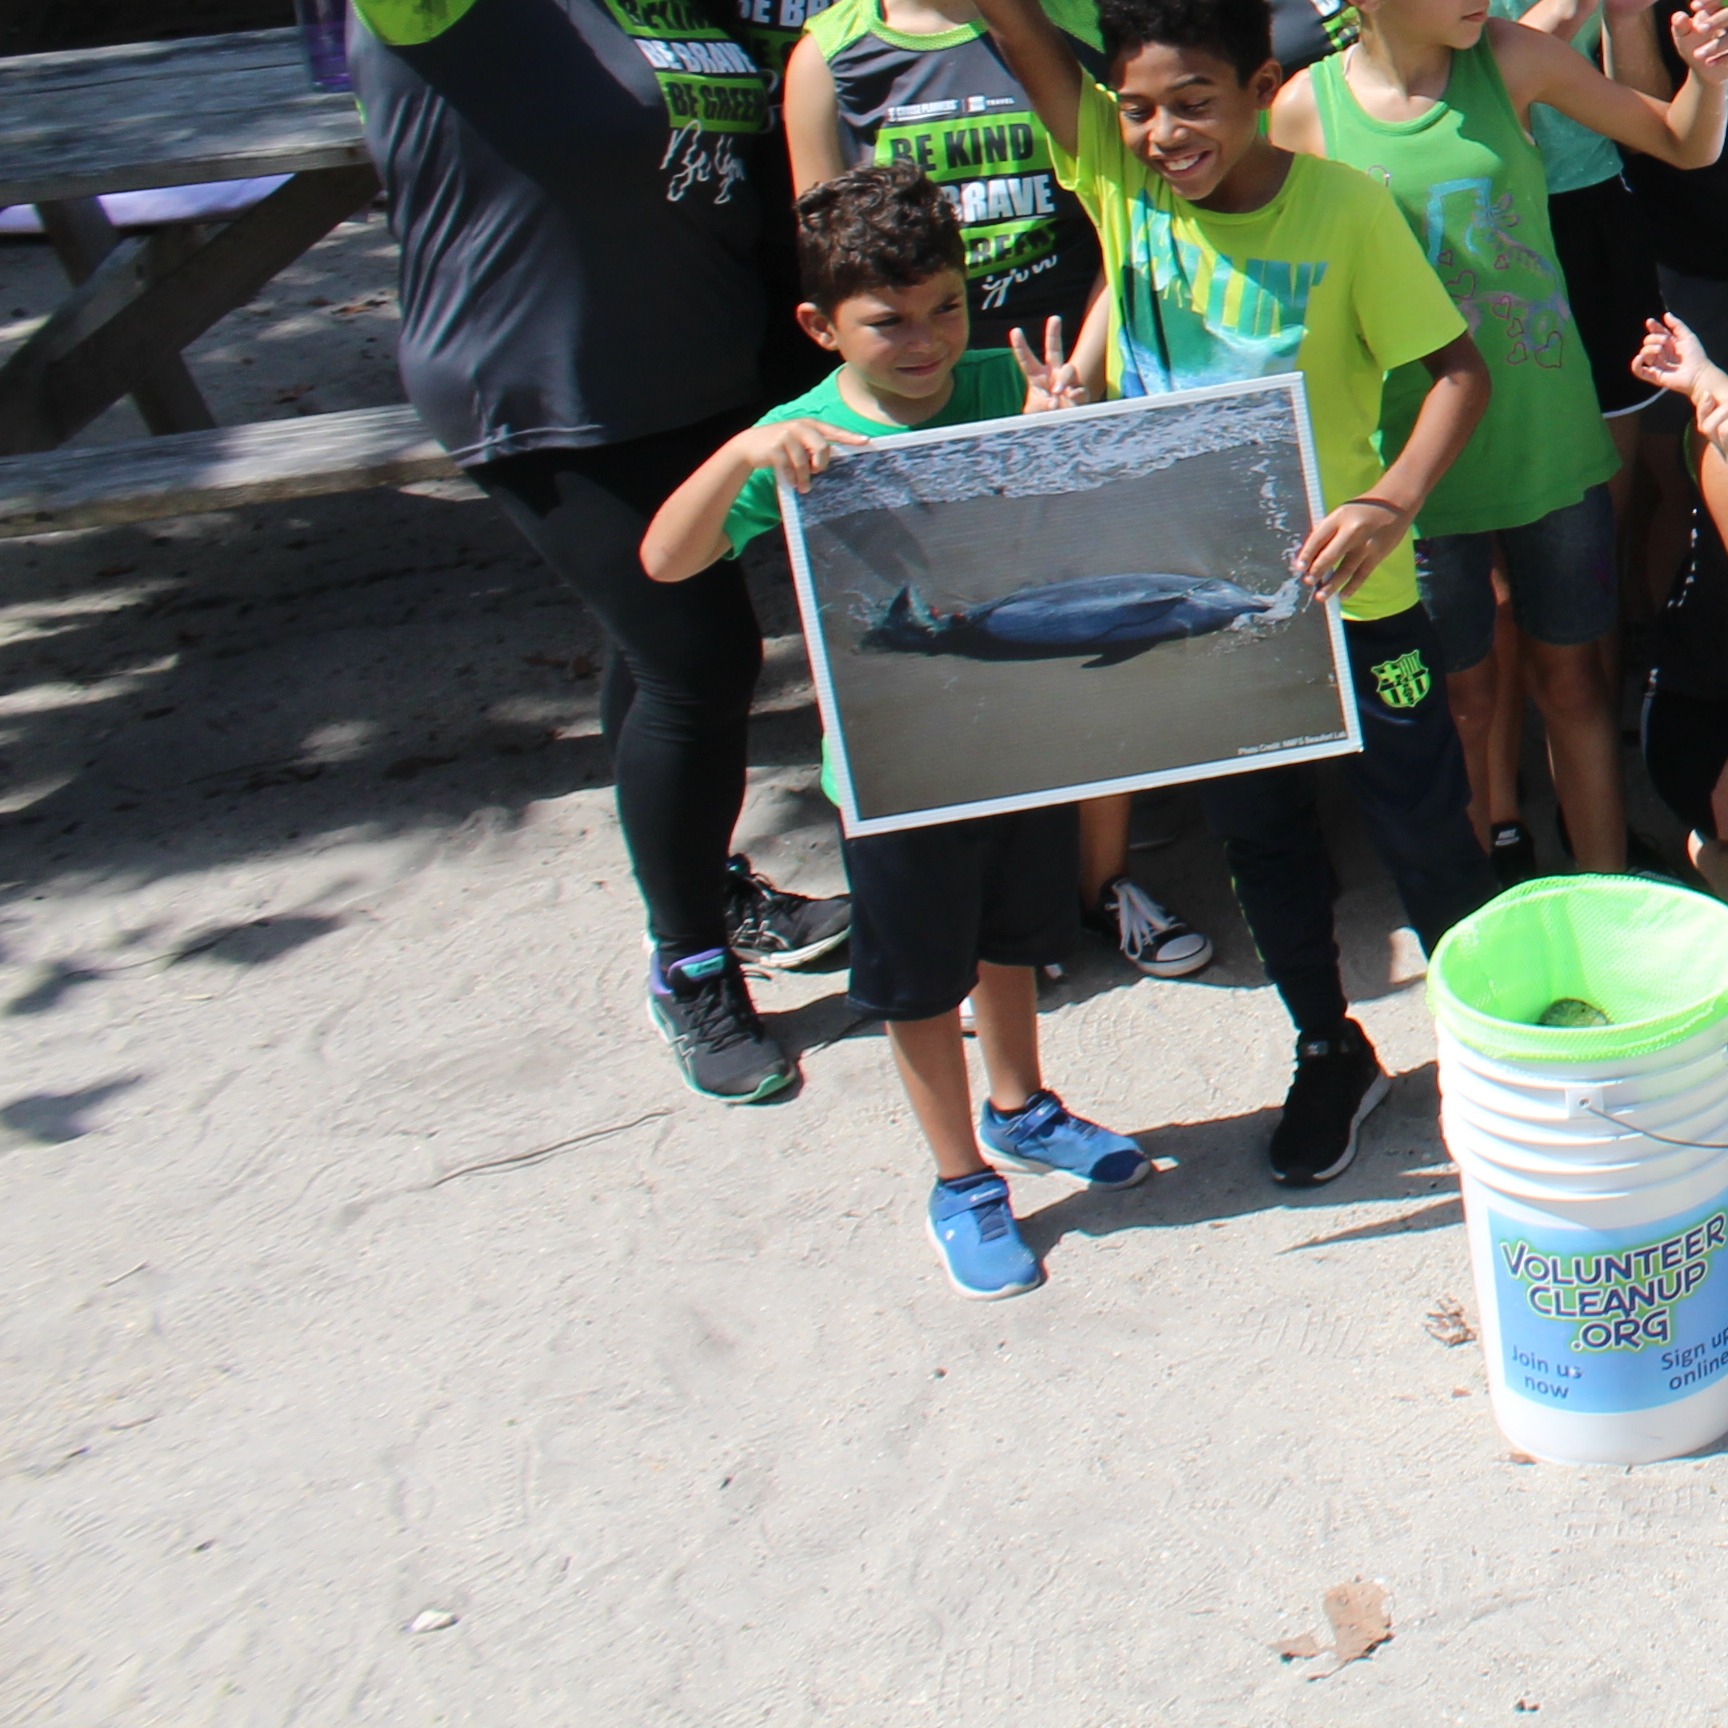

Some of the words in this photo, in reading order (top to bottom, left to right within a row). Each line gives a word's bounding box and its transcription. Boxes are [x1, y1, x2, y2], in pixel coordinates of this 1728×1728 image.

[666, 81, 699, 118] BE
[890, 134, 936, 171] BE
[944, 123, 1034, 170] KIND
[1500, 1213, 1726, 1285] VOLUNTEER
[1528, 1260, 1708, 1319] CLEANUP
[1572, 1308, 1669, 1351] .ORG
[1512, 1345, 1549, 1374] Join
[1556, 1363, 1582, 1379] us
[1661, 1342, 1706, 1371] Sign
[1524, 1375, 1570, 1400] now
